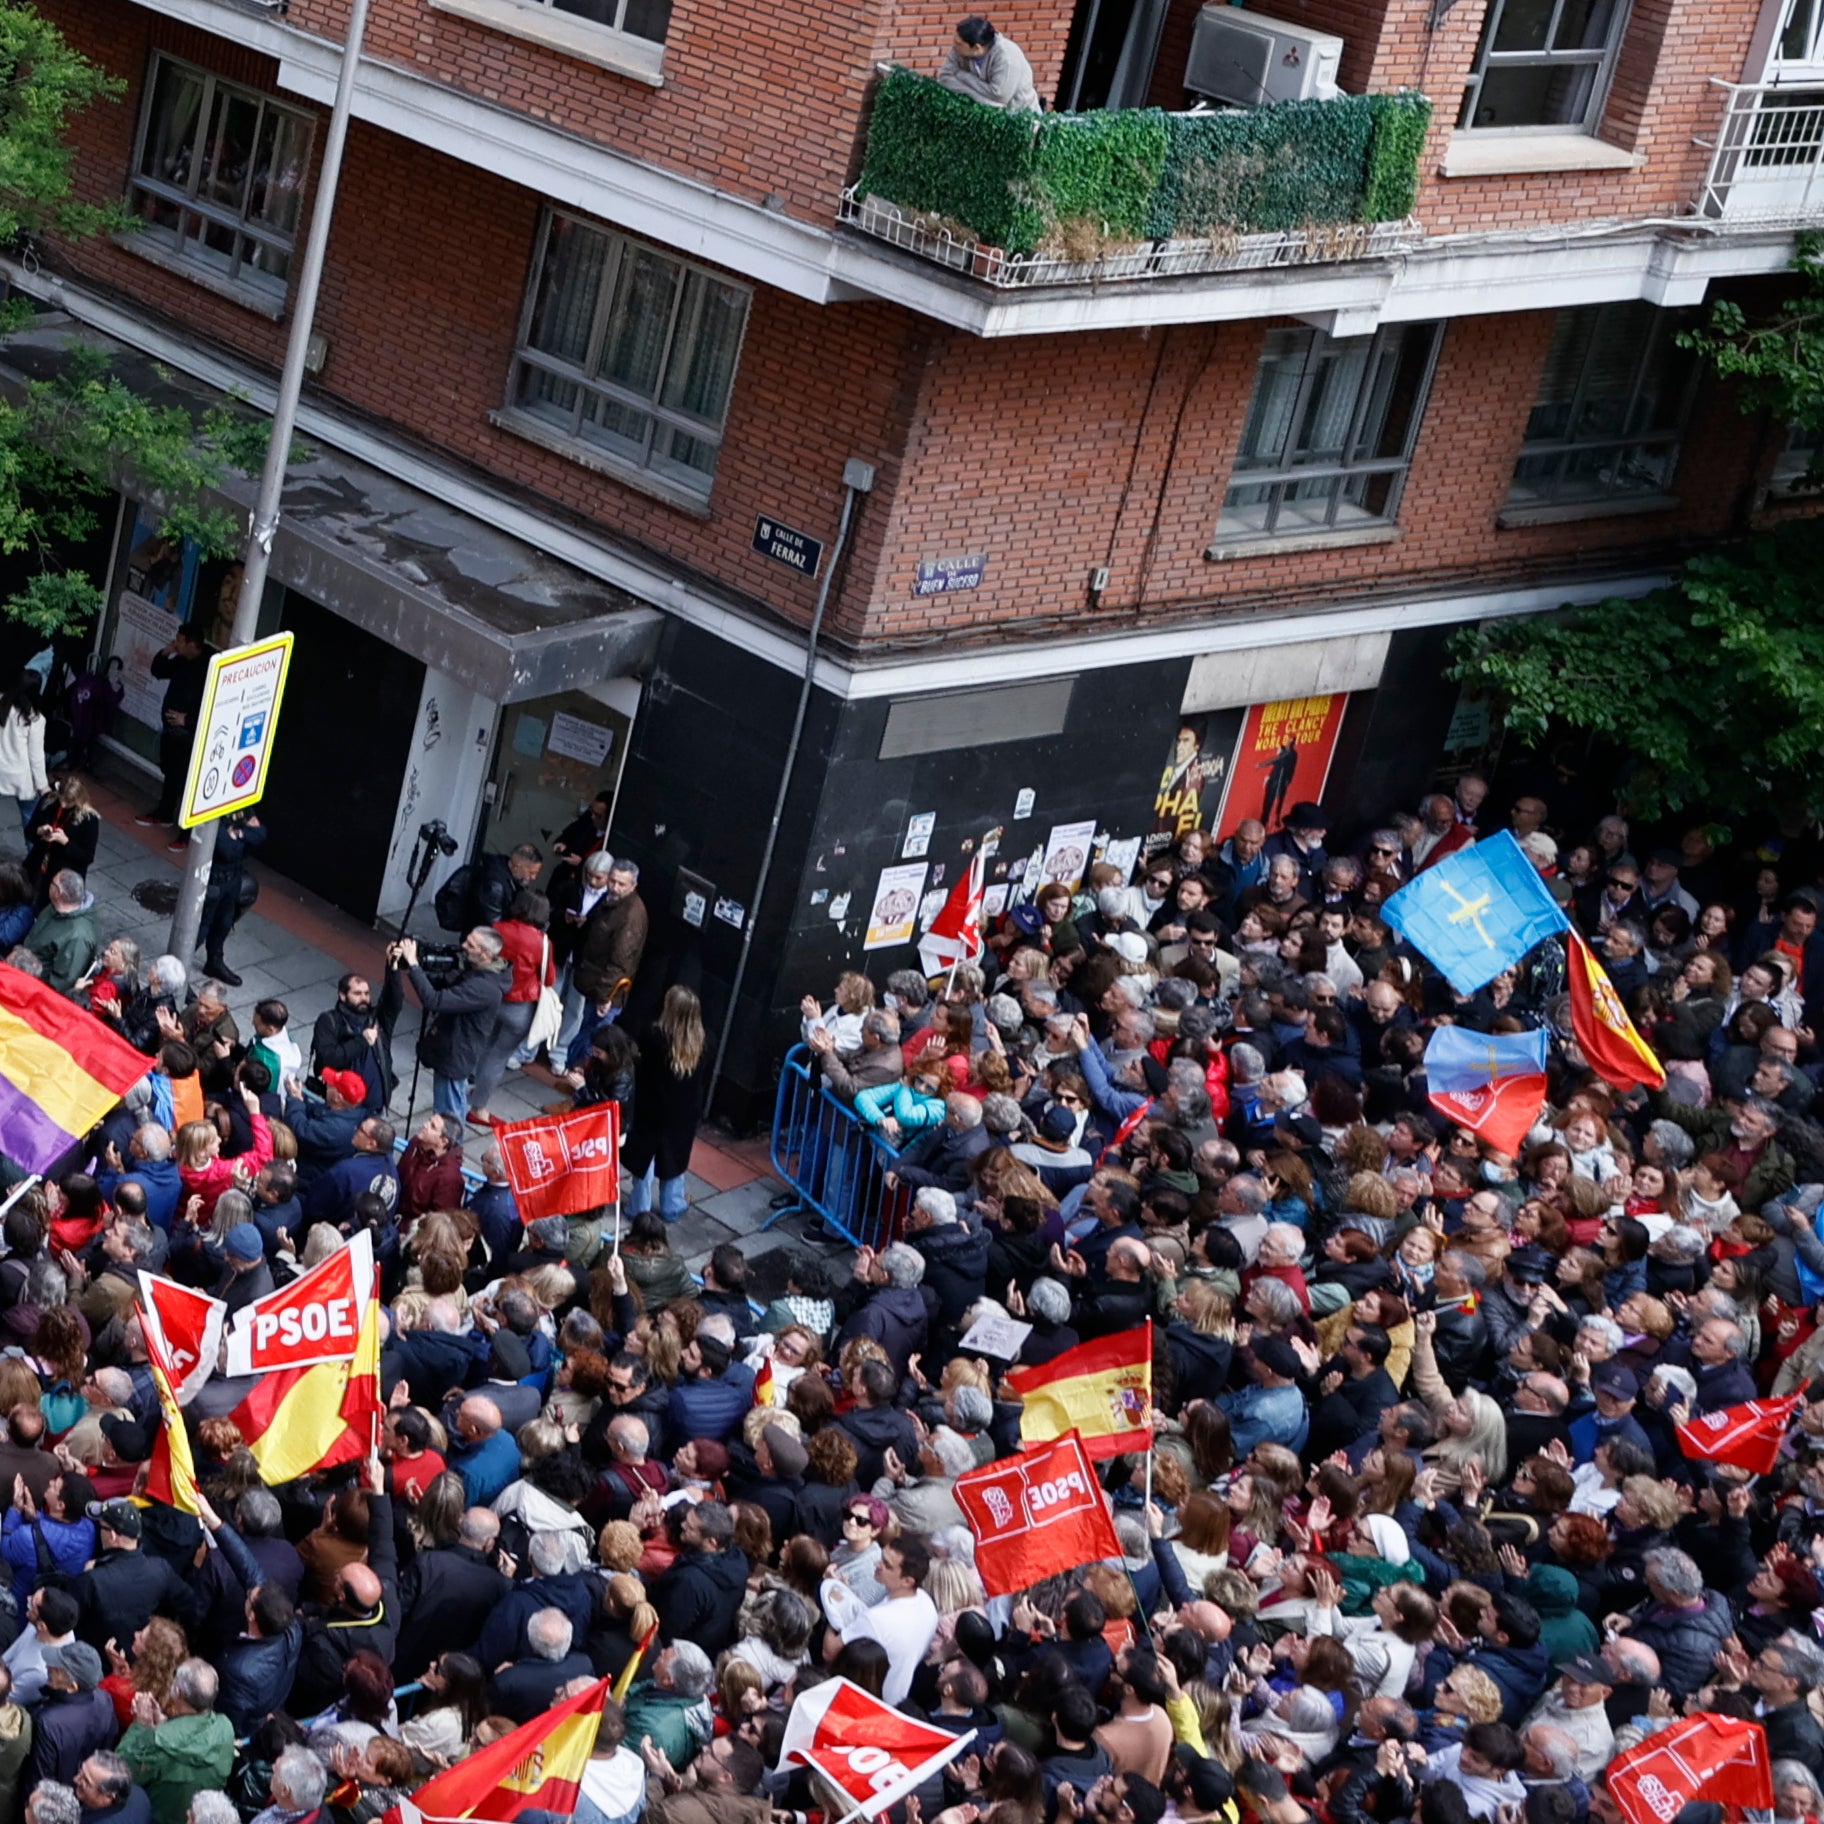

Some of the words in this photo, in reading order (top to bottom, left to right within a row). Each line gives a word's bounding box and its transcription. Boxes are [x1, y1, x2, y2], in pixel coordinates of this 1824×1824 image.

[775, 528, 793, 544] CALLE
[794, 537, 804, 548] DE
[771, 543, 806, 569] FERRAZ
[937, 557, 979, 570] CALLE
[1258, 721, 1278, 736] THE
[1285, 718, 1326, 733] CLANCY
[1295, 730, 1320, 743] TOUR
[255, 1298, 354, 1351] PSOE
